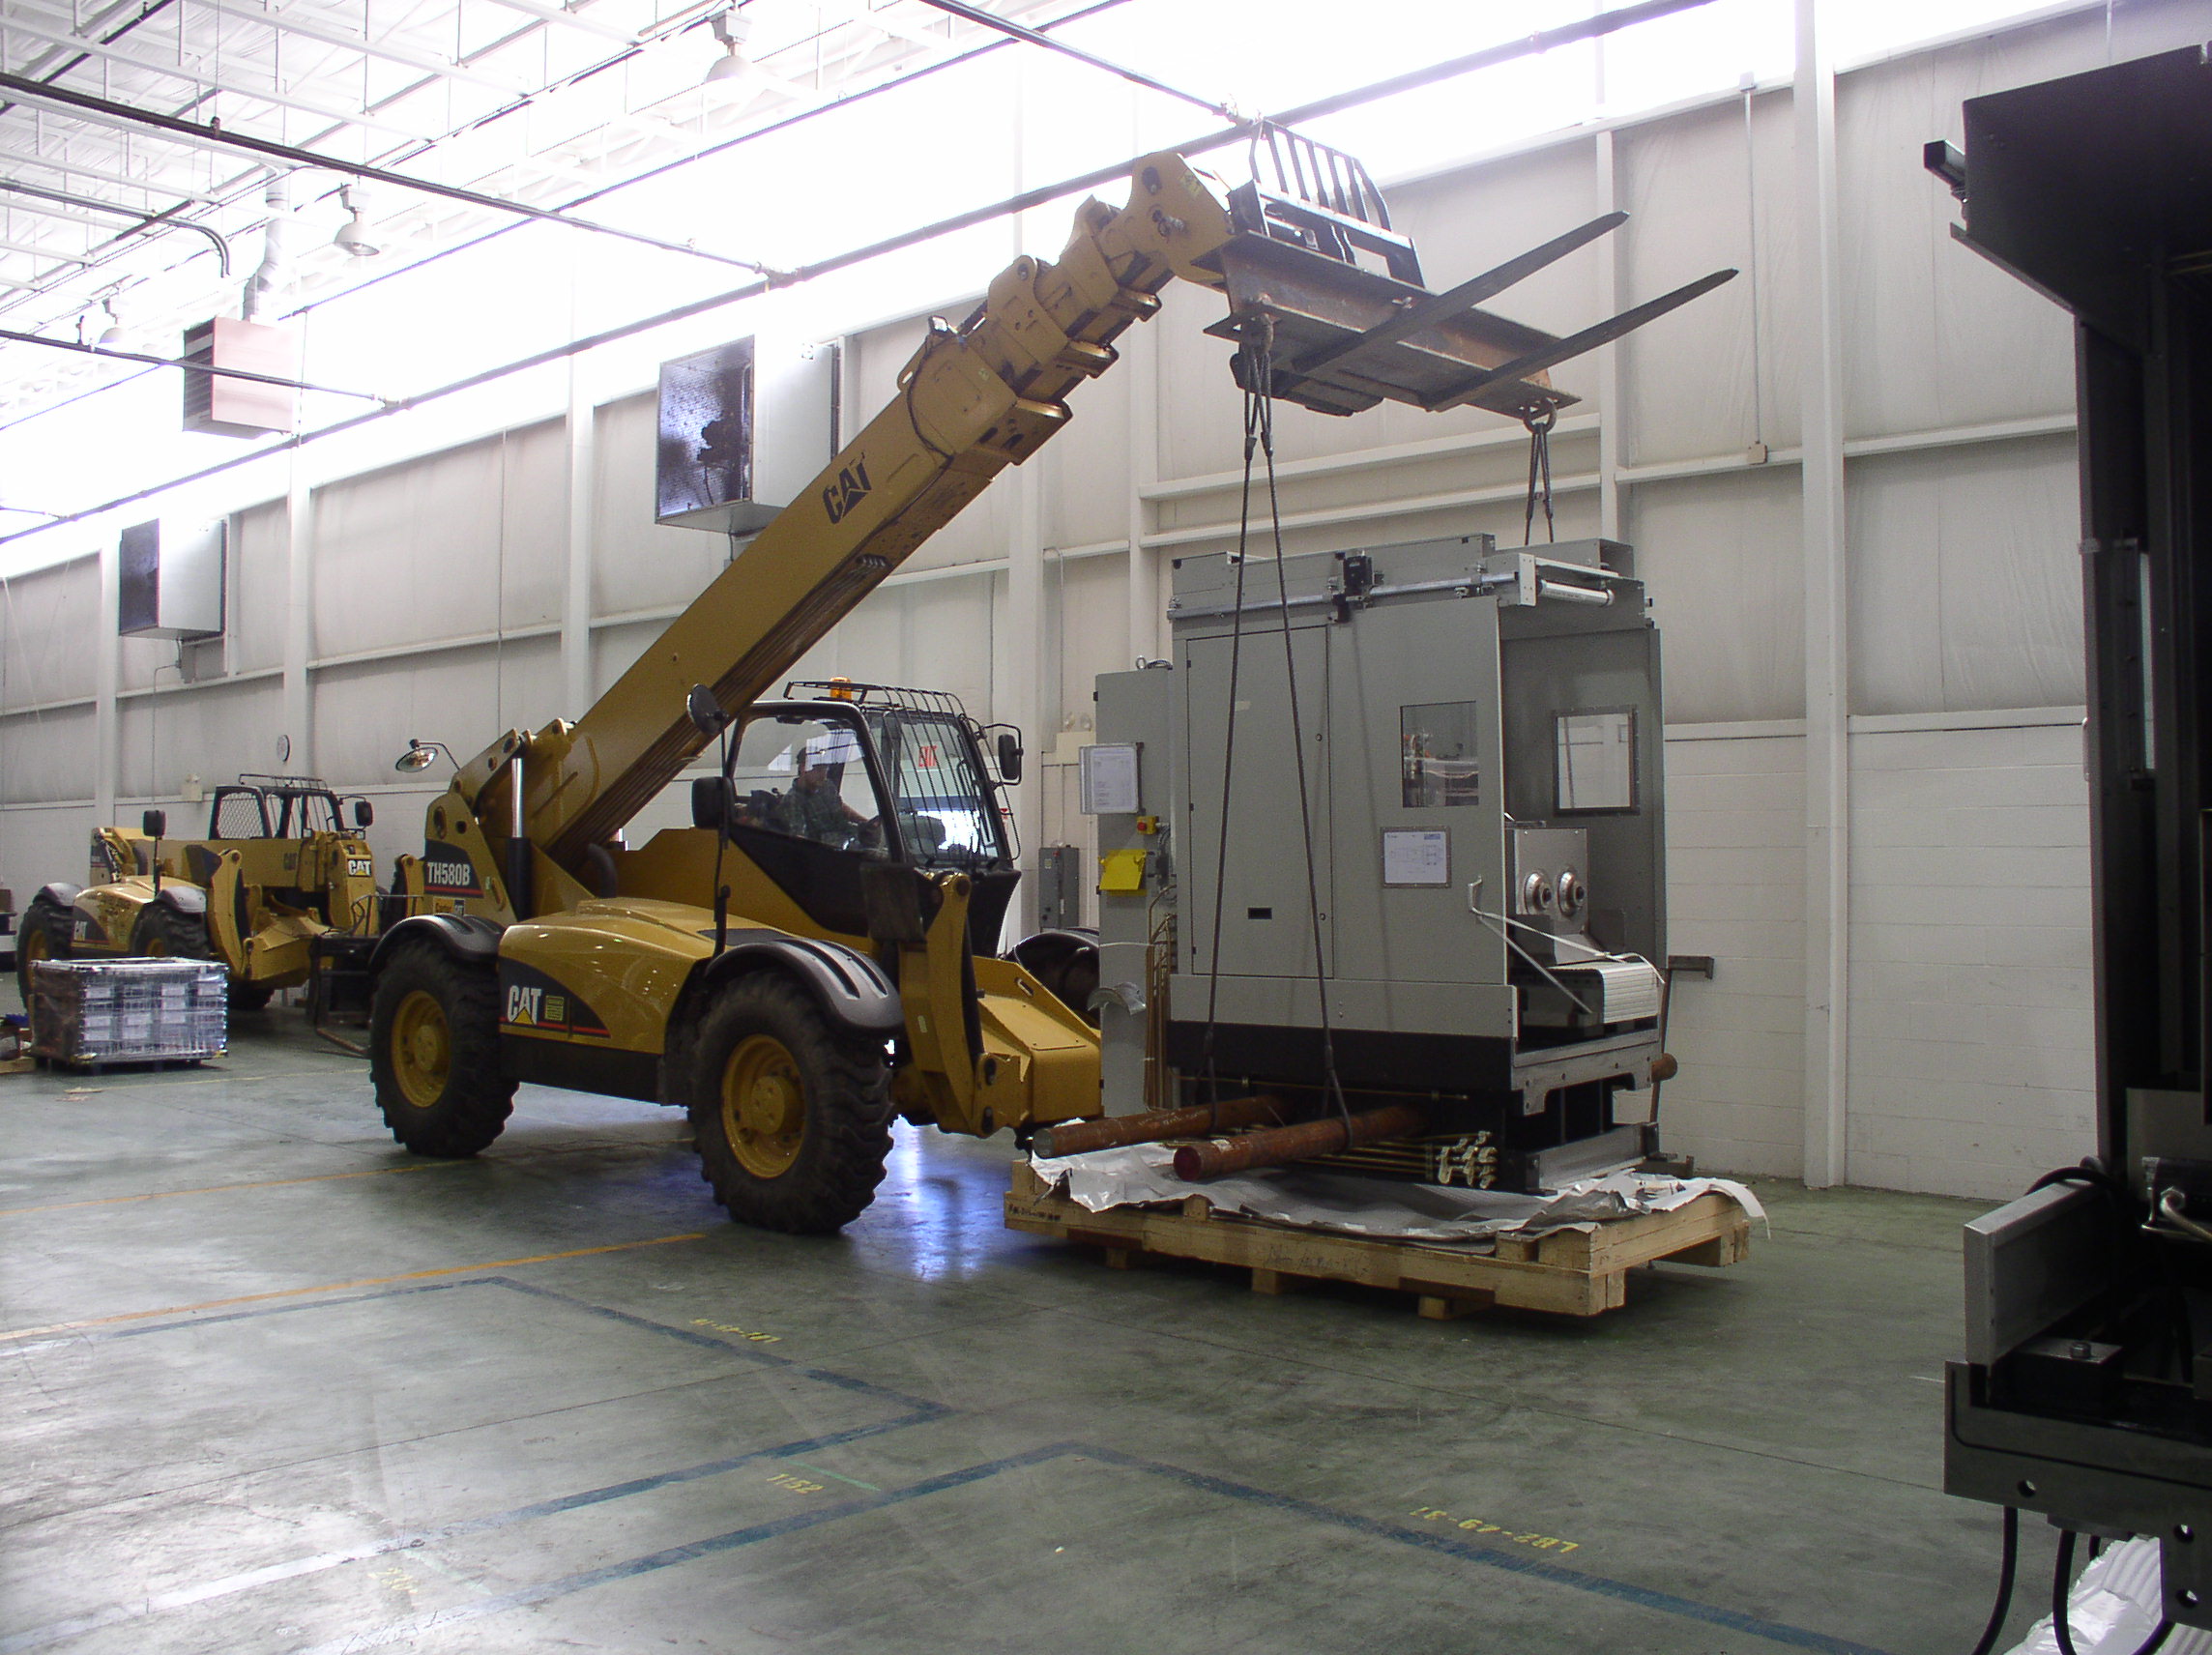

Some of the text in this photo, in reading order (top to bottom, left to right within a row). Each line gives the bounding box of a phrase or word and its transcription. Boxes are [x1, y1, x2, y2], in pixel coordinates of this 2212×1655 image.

[823, 453, 872, 524] CAT
[348, 859, 371, 876] CAT
[427, 861, 471, 886] TH580B
[508, 985, 541, 1025] CAT
